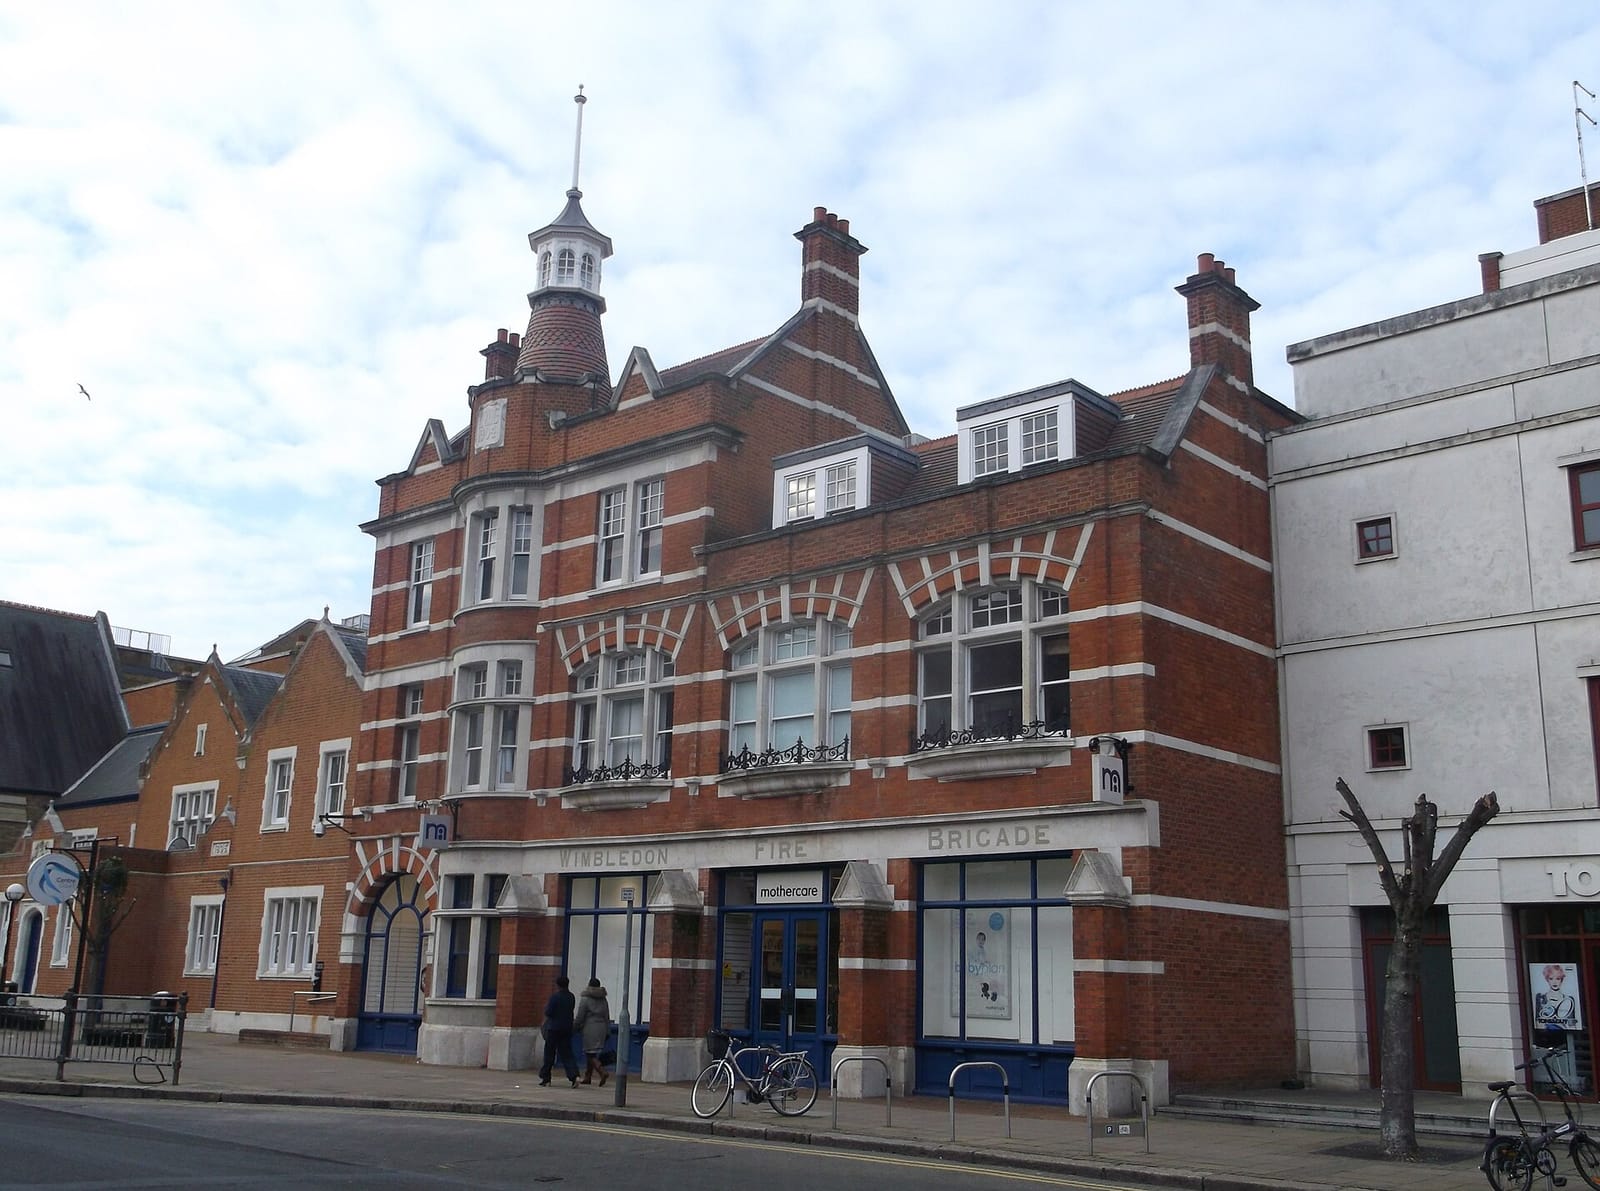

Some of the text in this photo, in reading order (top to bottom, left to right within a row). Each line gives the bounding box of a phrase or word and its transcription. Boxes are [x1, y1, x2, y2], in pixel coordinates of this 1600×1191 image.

[559, 824, 1051, 868] WIMBLEDON FIRE BRIGADE
[760, 884, 819, 898] mothercare
